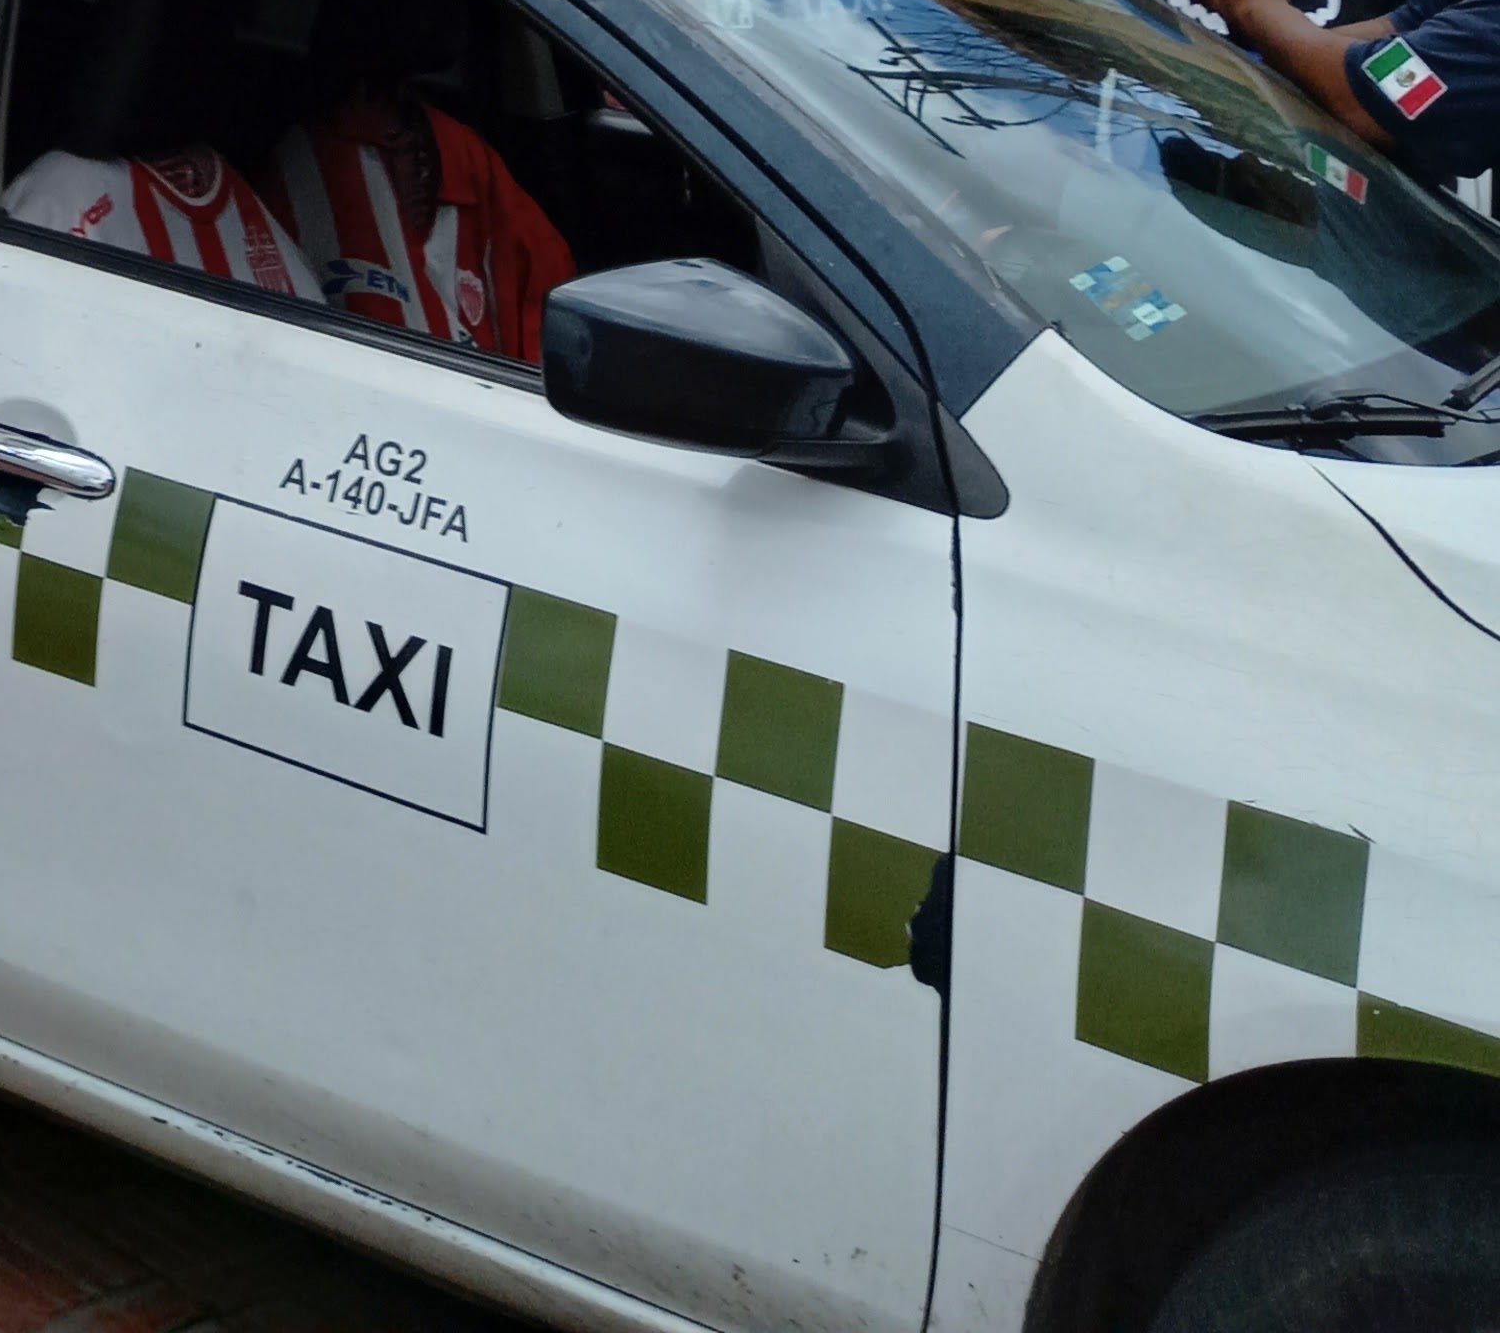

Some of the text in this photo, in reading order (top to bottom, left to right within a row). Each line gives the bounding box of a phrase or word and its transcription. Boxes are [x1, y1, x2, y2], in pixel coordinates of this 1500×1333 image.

[279, 457, 469, 543] A-140-JFA
[343, 432, 429, 485] AG2
[237, 579, 454, 738] TAXI
